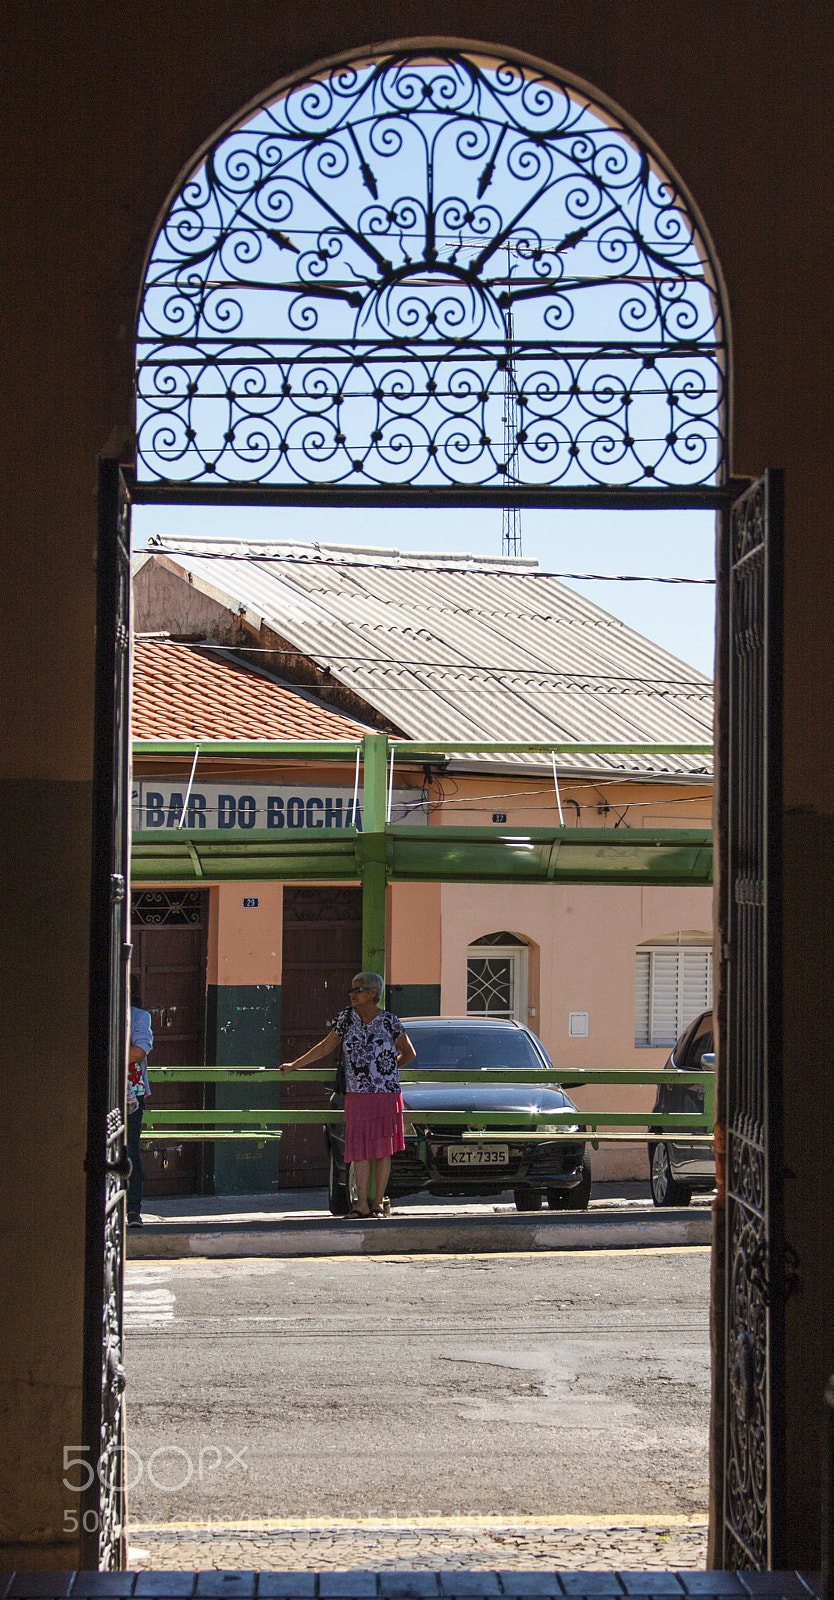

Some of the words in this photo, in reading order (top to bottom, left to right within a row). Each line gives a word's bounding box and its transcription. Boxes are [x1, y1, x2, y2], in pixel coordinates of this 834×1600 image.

[146, 792, 206, 828] BAR
[218, 795, 256, 829] DO
[267, 796, 363, 832] BOCHA
